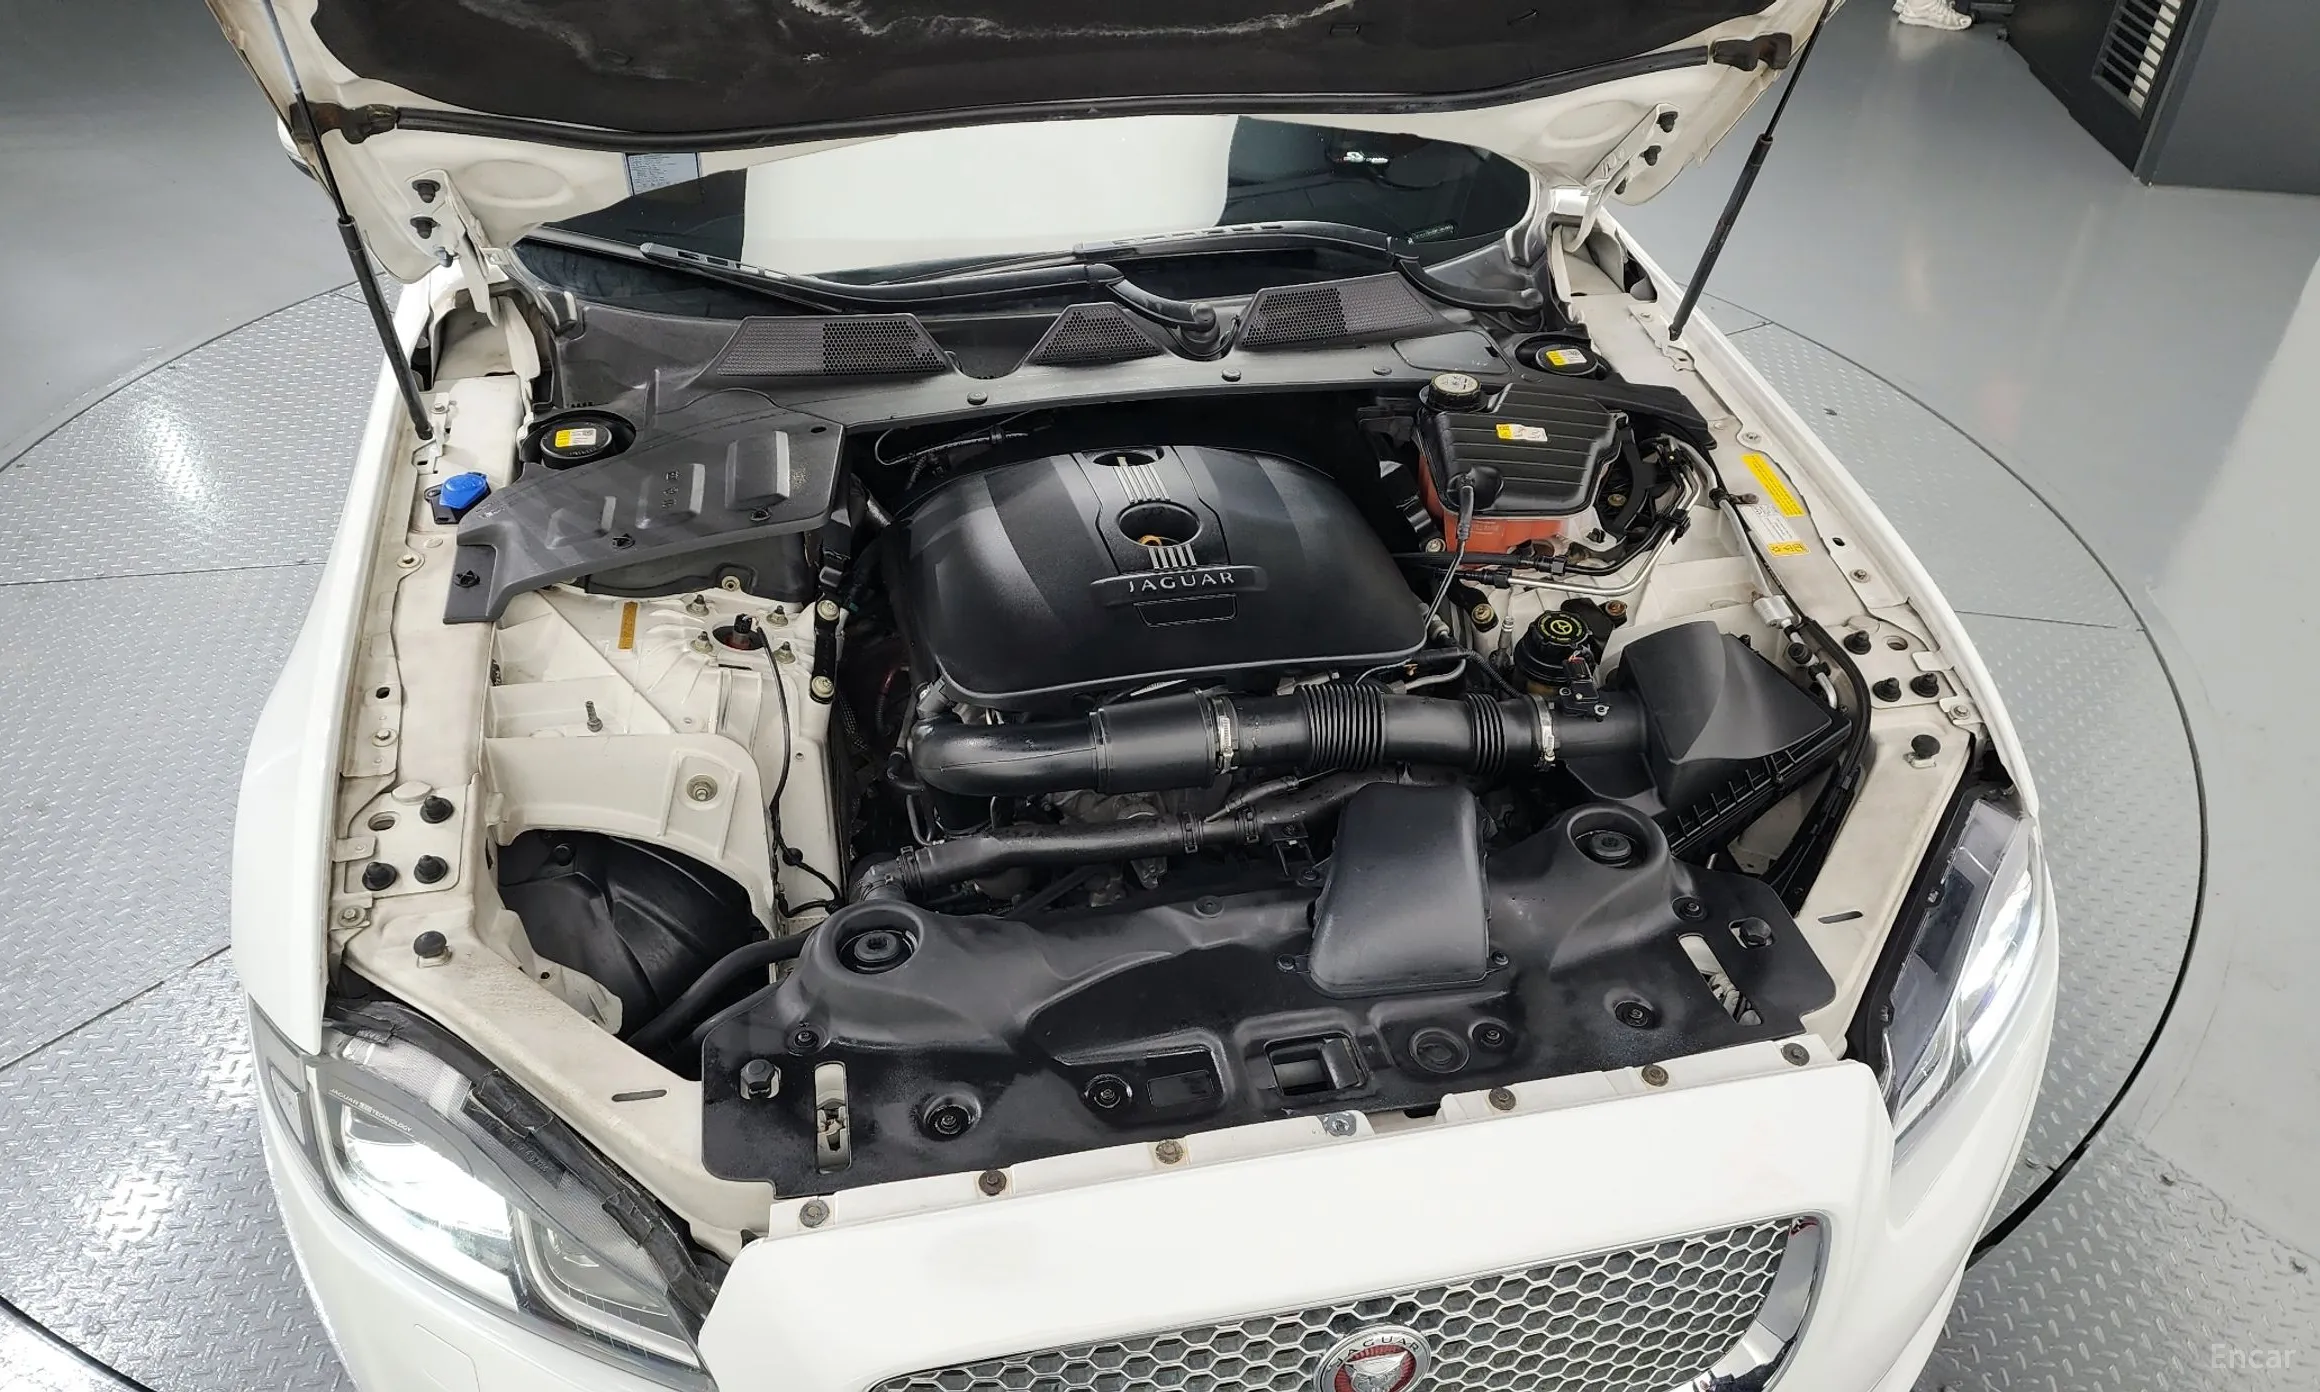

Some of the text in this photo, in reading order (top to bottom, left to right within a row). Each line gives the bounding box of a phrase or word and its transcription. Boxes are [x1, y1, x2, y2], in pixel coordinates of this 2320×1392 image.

[1129, 572, 1235, 593] JAGUAR
[329, 1088, 413, 1132] JAGUAR TECHNOLOGY
[1334, 1336, 1420, 1368] JAGUAR
